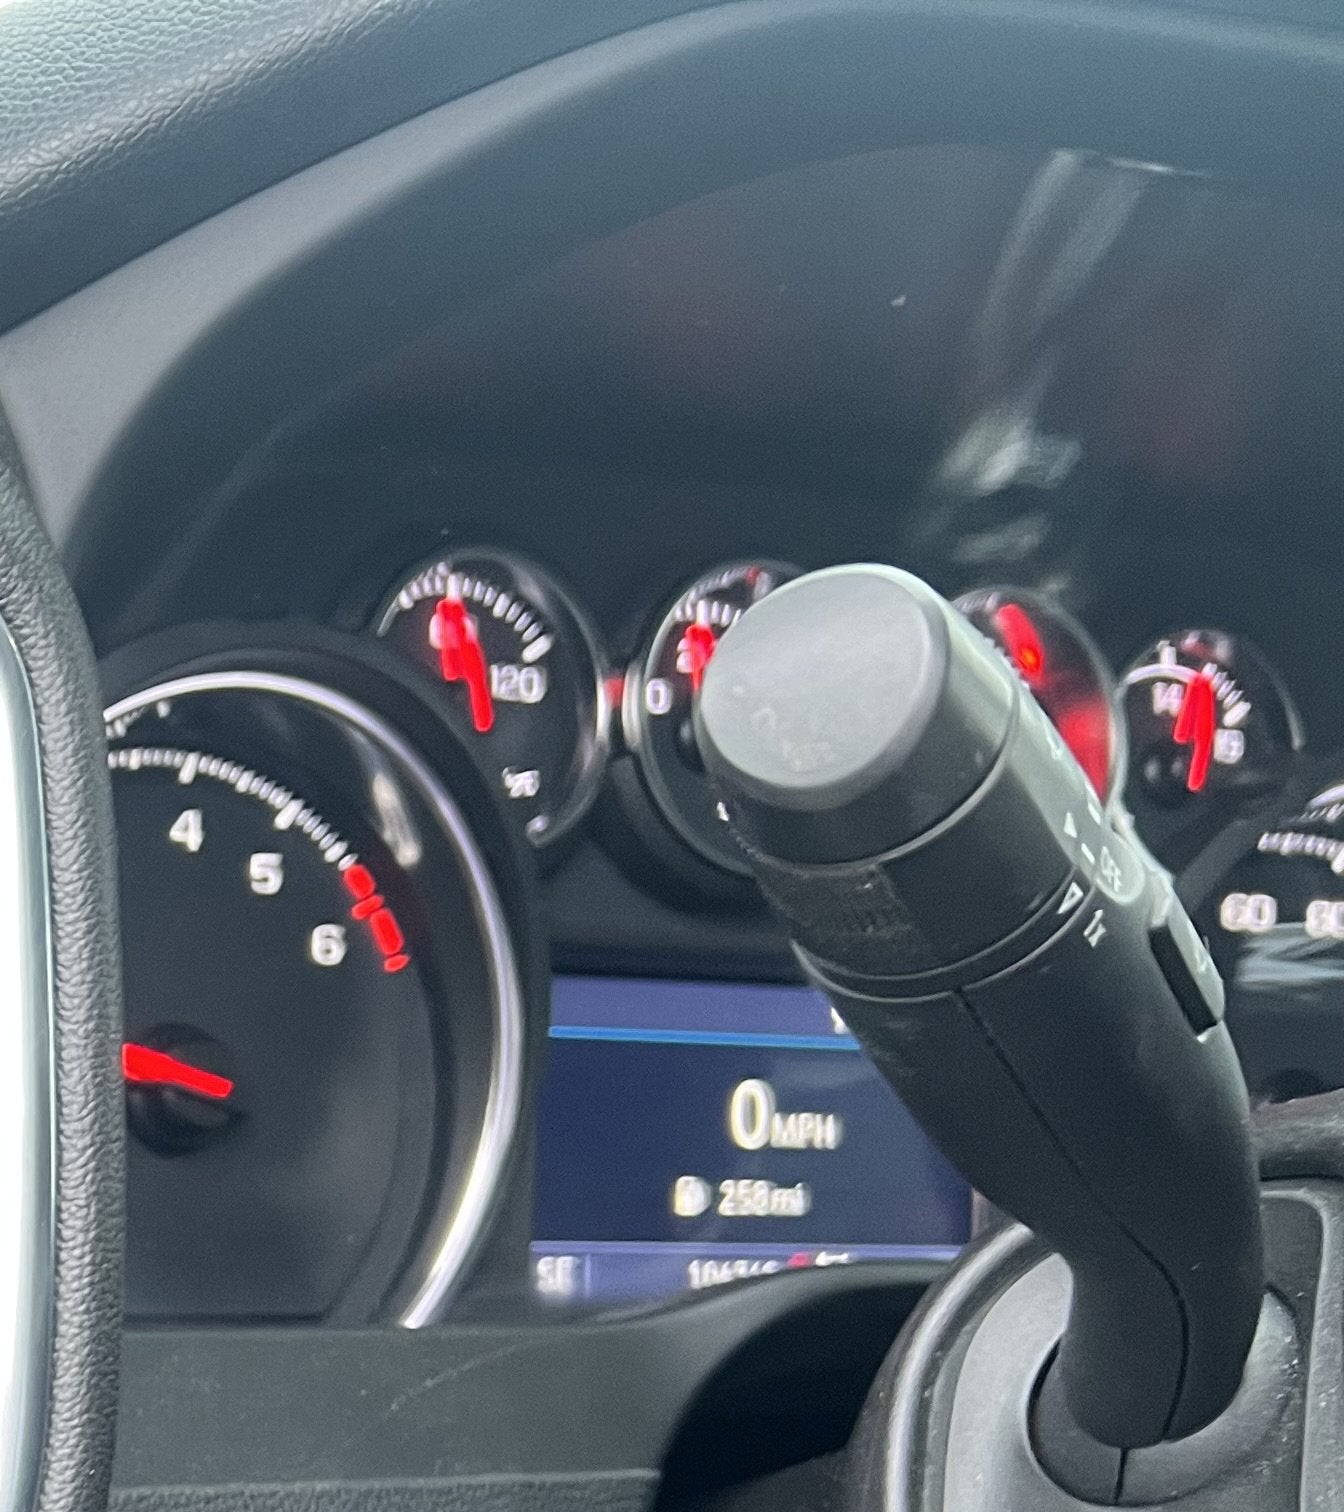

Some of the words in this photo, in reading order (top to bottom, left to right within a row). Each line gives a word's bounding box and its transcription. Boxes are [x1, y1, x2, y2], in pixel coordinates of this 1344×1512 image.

[646, 677, 673, 715] 0
[169, 808, 204, 852] 4
[249, 852, 284, 895] 5
[1220, 893, 1277, 934] 60
[311, 923, 347, 967] 6
